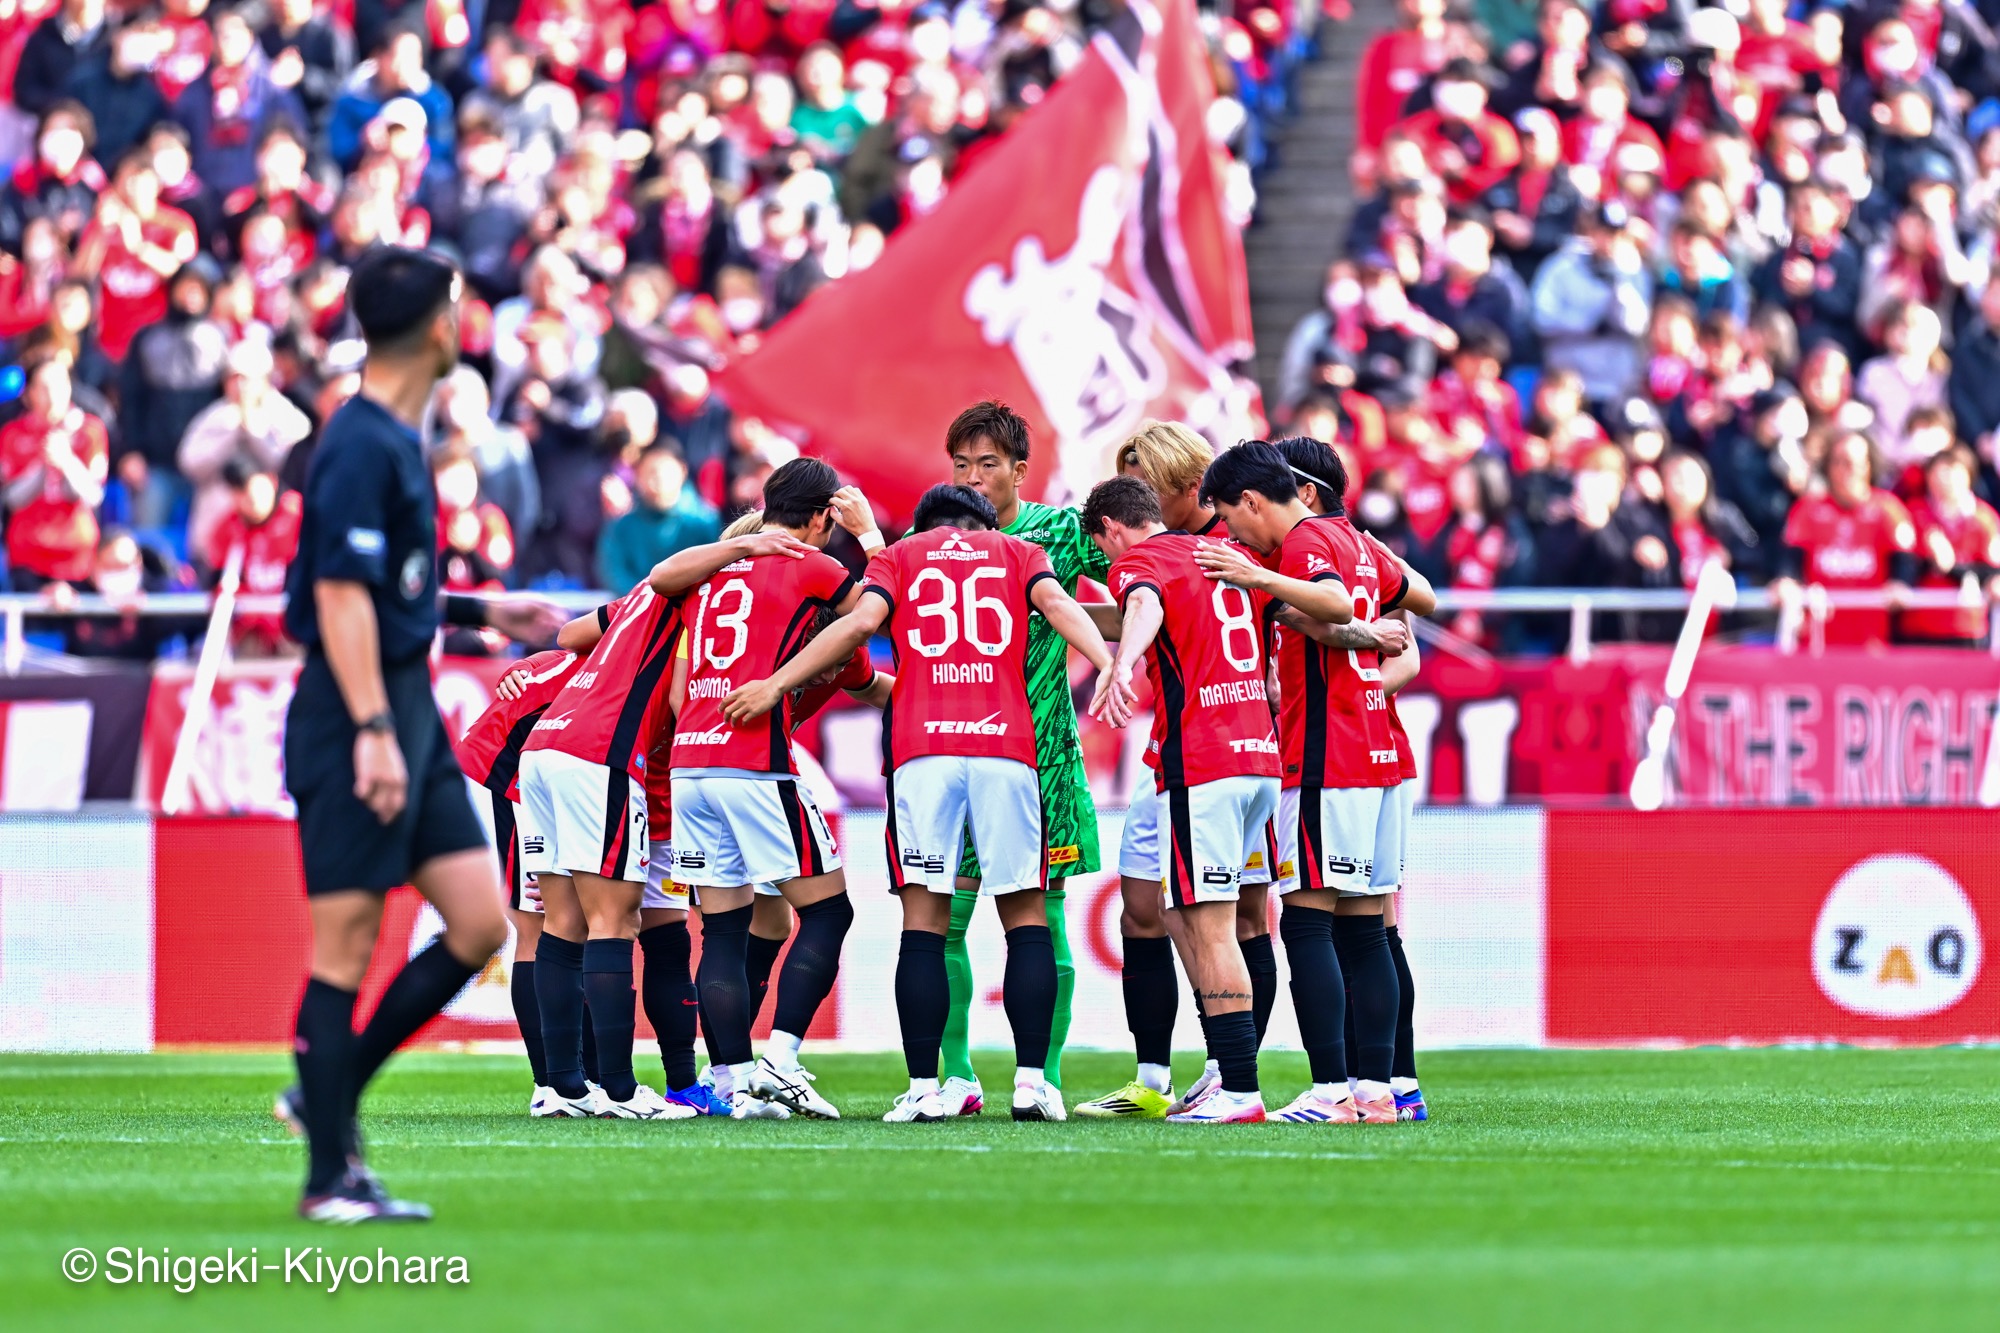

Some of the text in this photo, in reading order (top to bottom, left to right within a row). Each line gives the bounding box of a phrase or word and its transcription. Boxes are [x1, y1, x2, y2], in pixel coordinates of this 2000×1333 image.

[692, 578, 754, 674] 13
[907, 566, 1014, 658] 36
[1211, 579, 1261, 673] 8
[932, 662, 994, 685] HIDANO
[1695, 684, 1822, 806] THE
[1831, 925, 1966, 988] ZAQ
